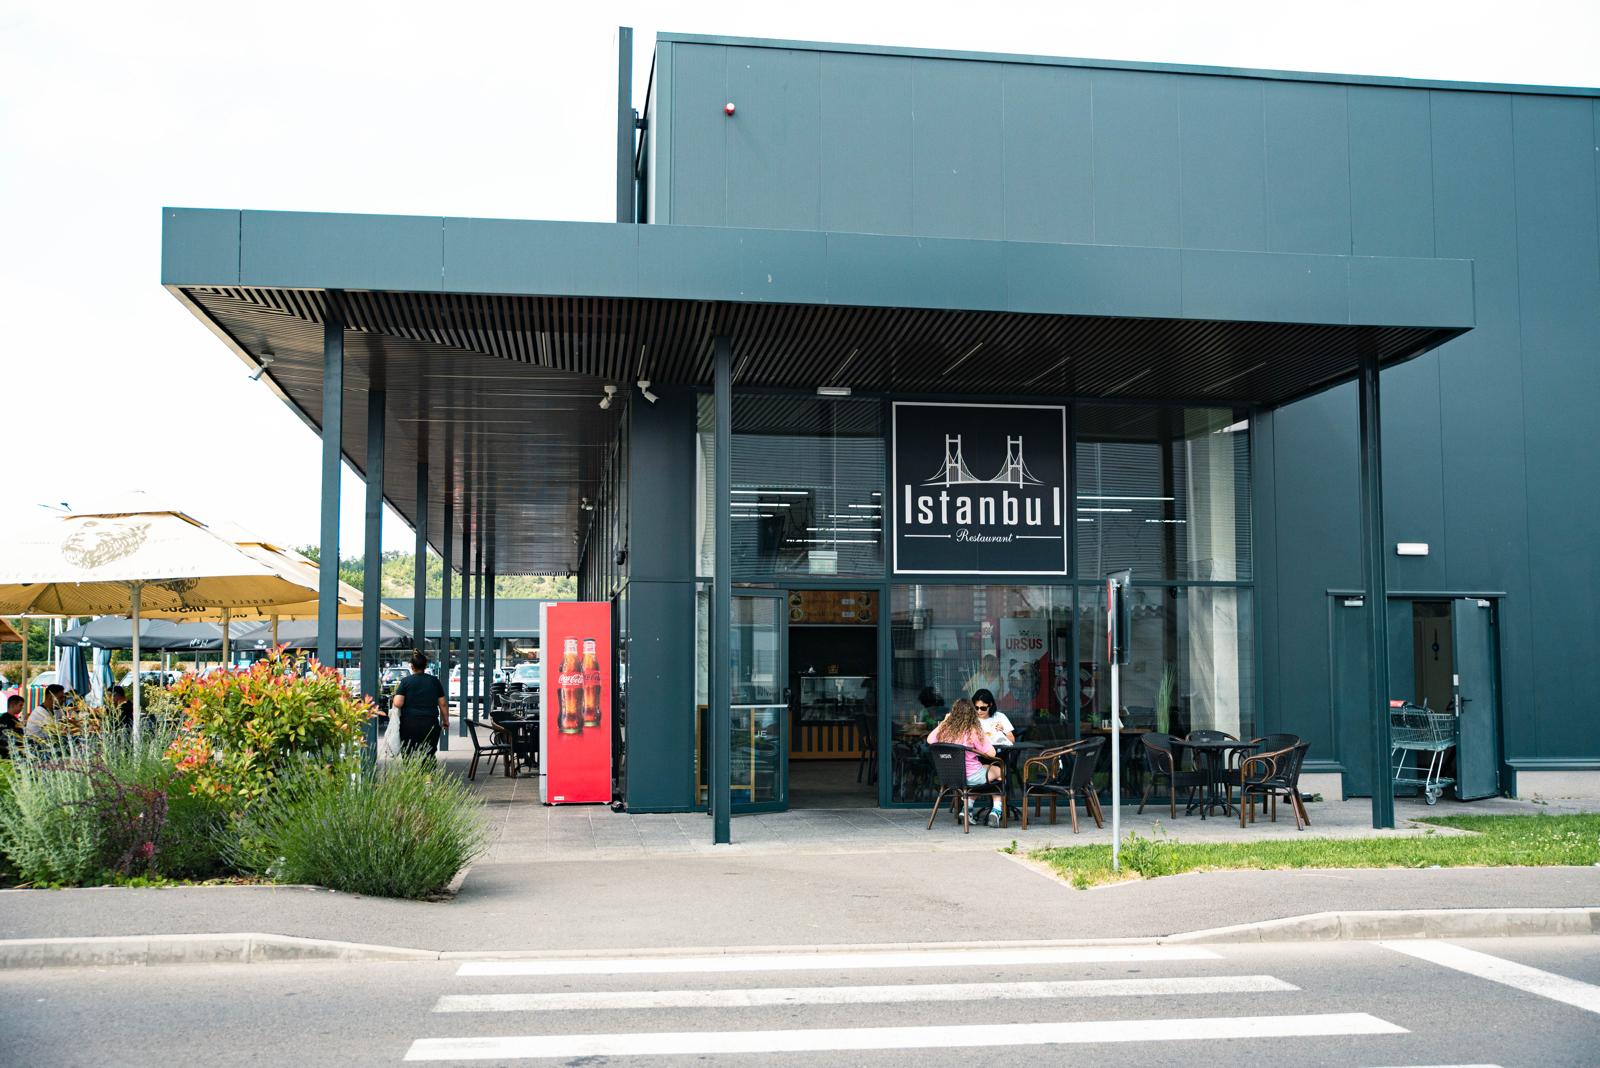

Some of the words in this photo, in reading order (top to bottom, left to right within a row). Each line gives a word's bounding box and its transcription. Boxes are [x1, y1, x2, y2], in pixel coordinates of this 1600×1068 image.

[905, 484, 1061, 526] Istanbul
[956, 529, 1013, 543] Restaurant
[1005, 638, 1043, 650] URSUS
